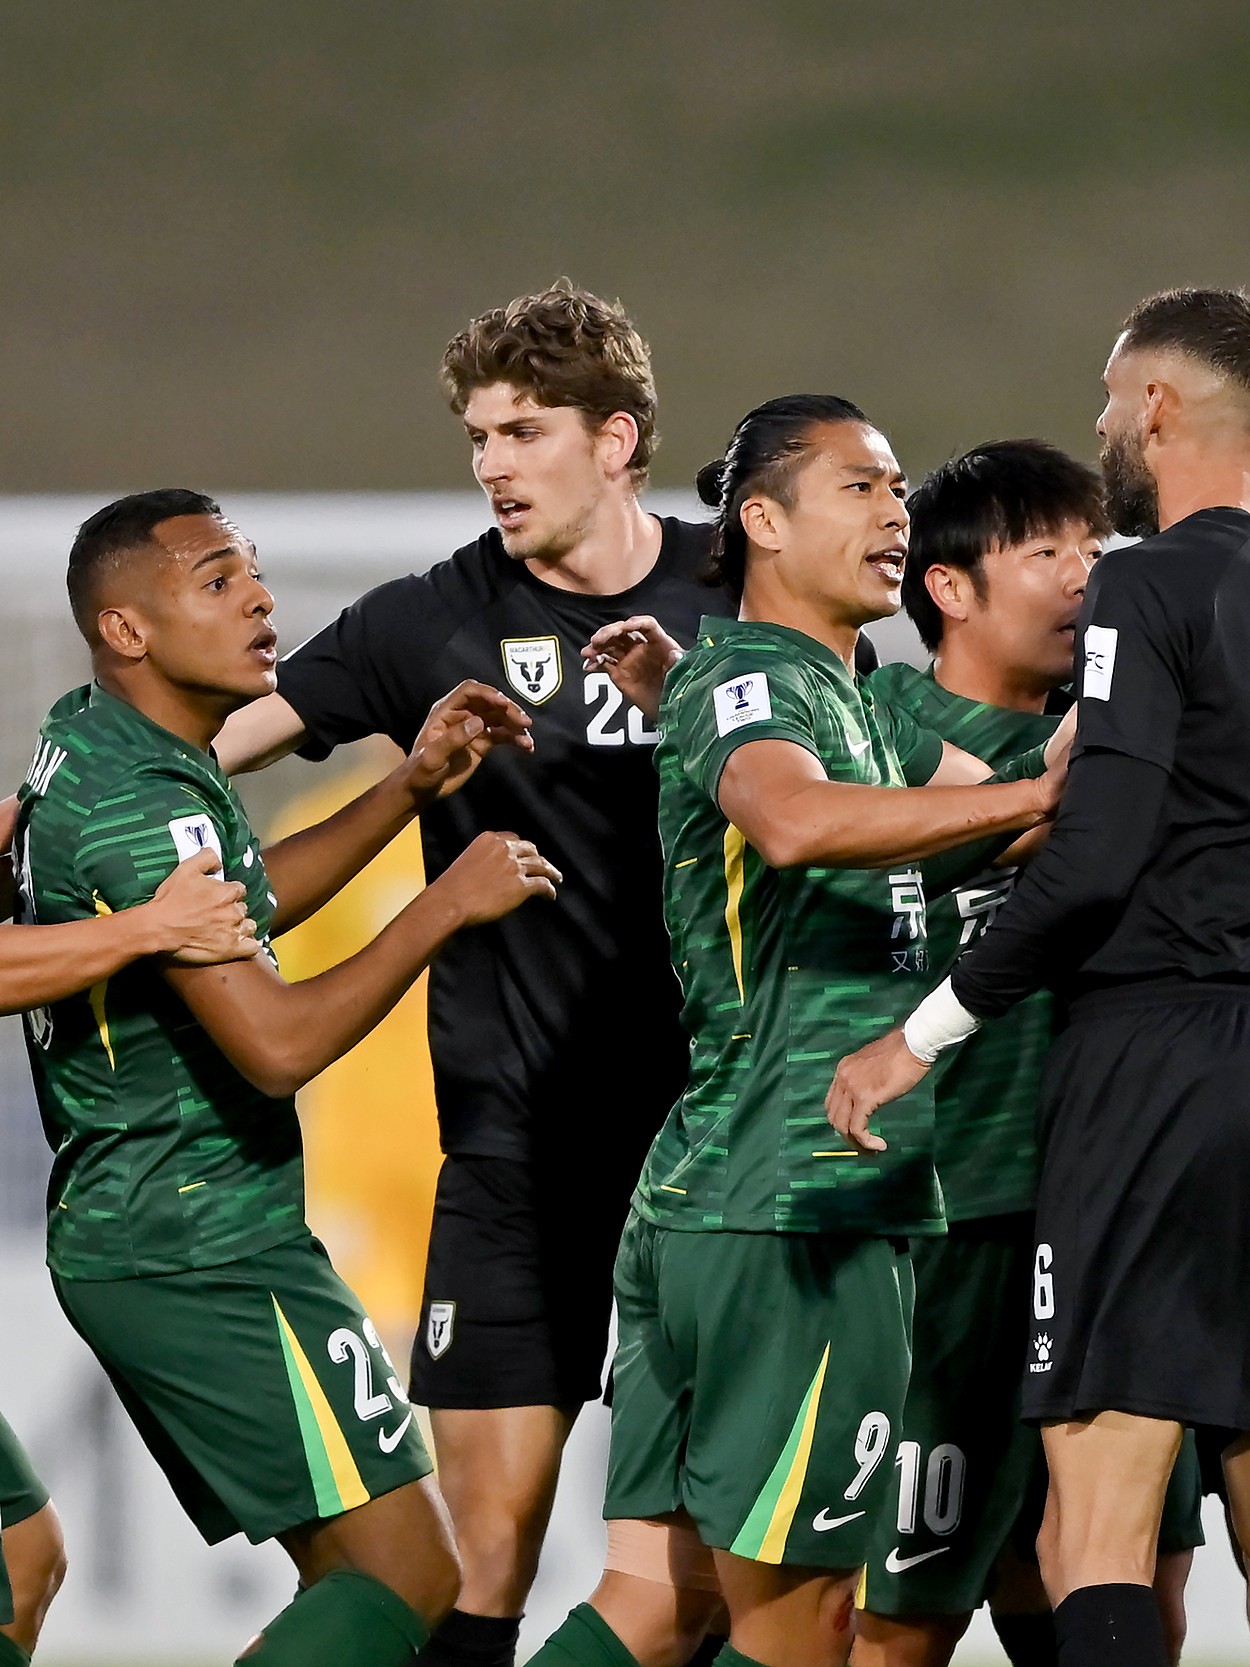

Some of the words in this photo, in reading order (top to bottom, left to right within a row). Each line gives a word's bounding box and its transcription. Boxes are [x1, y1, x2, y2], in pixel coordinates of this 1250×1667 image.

[1033, 1242, 1056, 1321] 6
[843, 1410, 891, 1501] 9
[895, 1440, 967, 1536] 10
